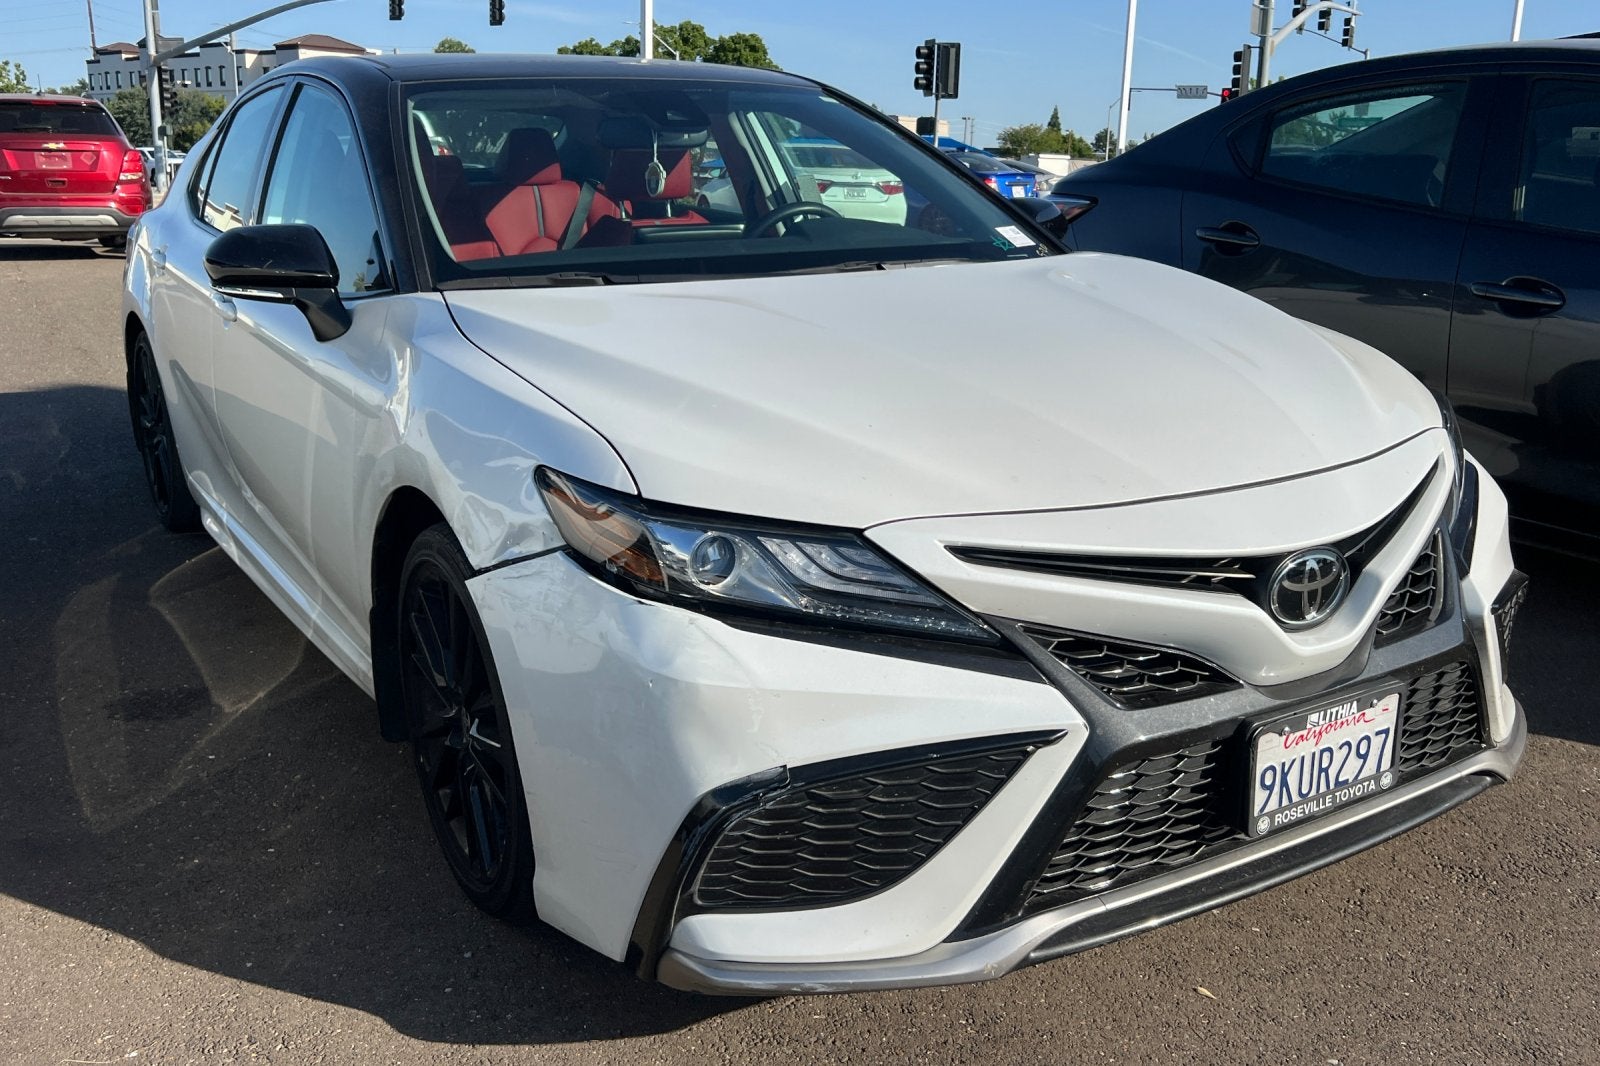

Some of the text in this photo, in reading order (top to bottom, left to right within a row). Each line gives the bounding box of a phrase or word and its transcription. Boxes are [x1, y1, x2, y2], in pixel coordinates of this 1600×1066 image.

[1284, 711, 1375, 749] California
[1319, 702, 1358, 726] LITHIA
[1259, 729, 1389, 814] 9KUR297
[1275, 779, 1376, 826] ROSEVILLE TOYOTA
